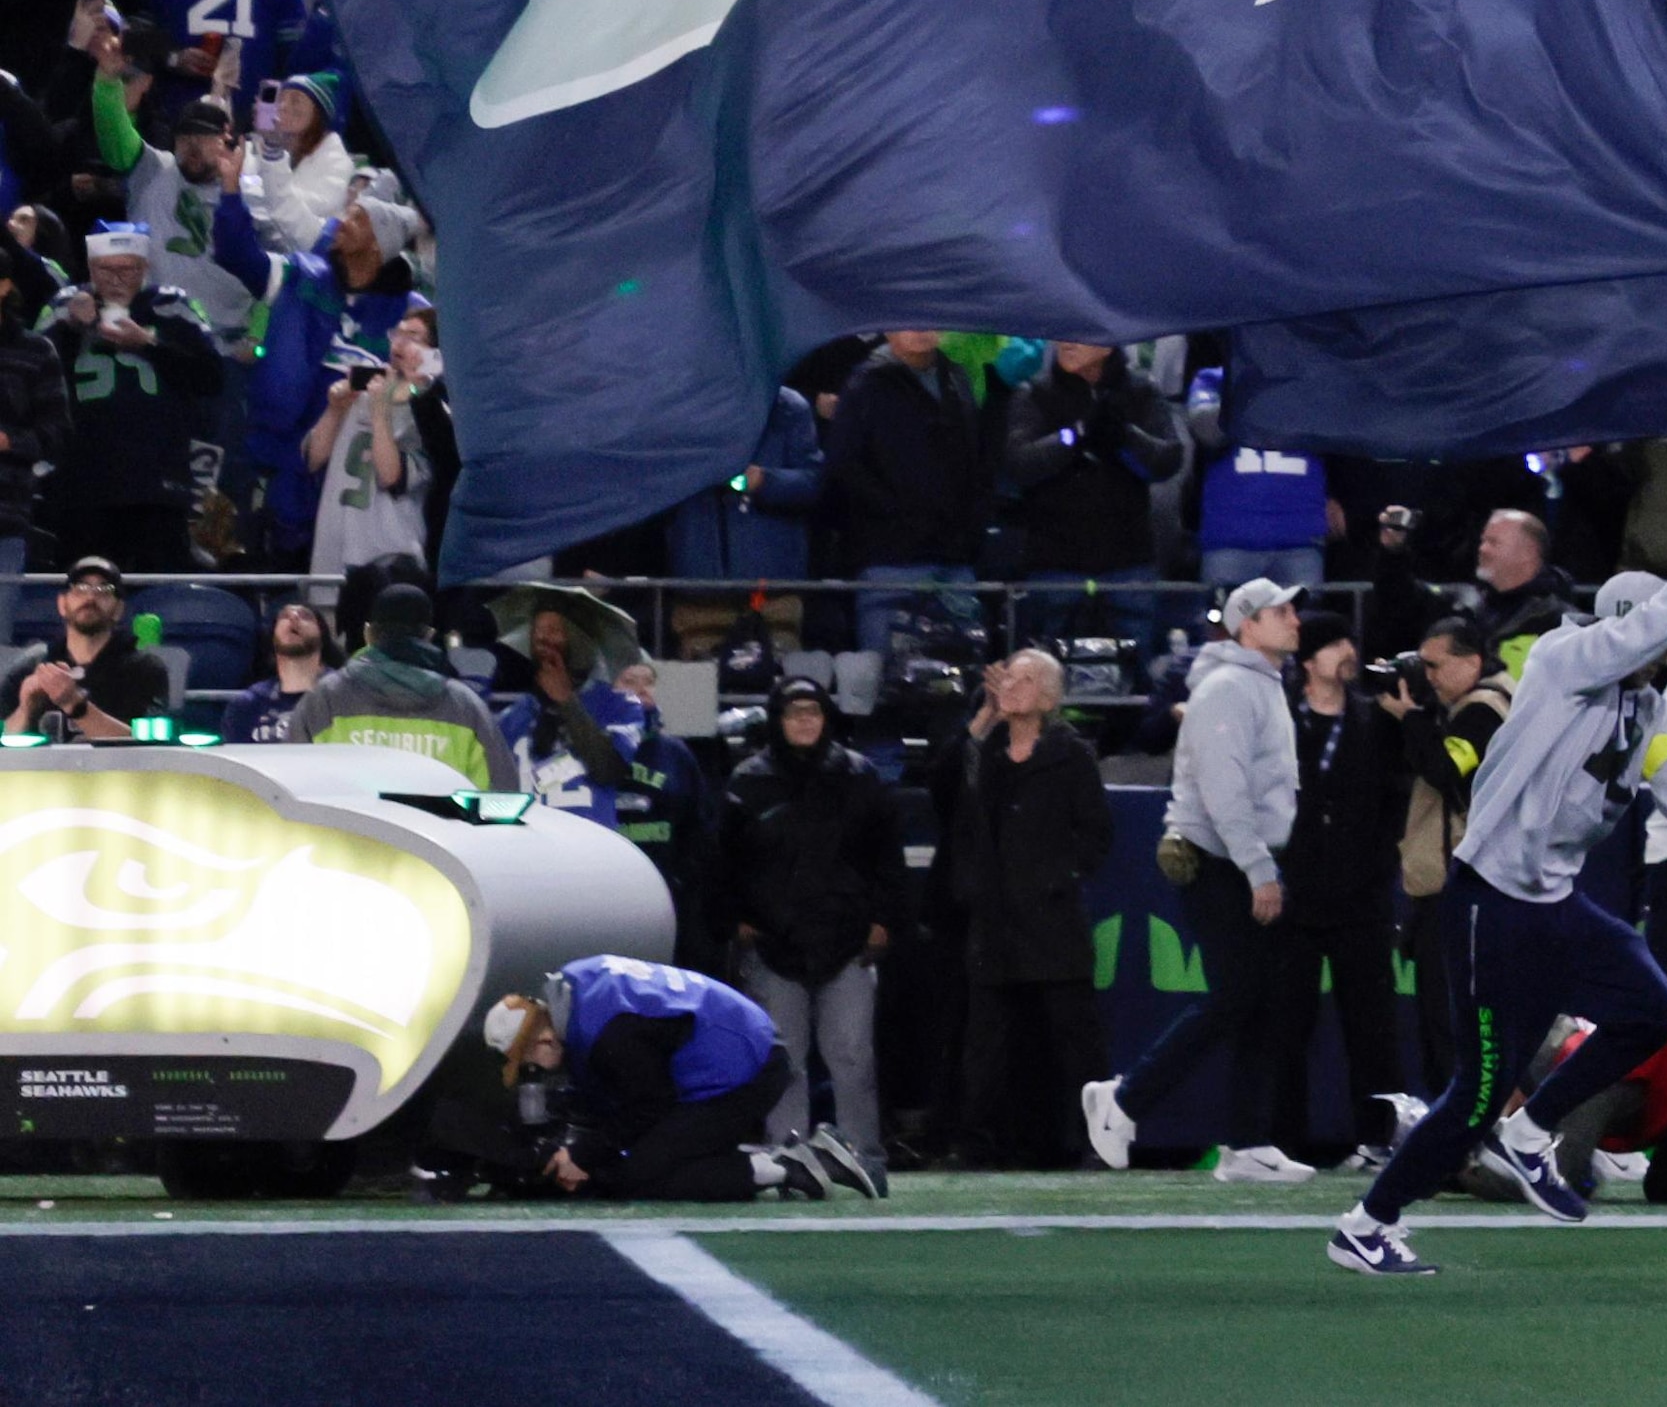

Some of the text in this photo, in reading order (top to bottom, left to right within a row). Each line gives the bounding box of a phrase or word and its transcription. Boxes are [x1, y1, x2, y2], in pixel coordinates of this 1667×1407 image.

[351, 732, 469, 763] SECURITY
[20, 1070, 108, 1083] SEATTLE
[20, 1084, 127, 1097] SEAHAWKS
